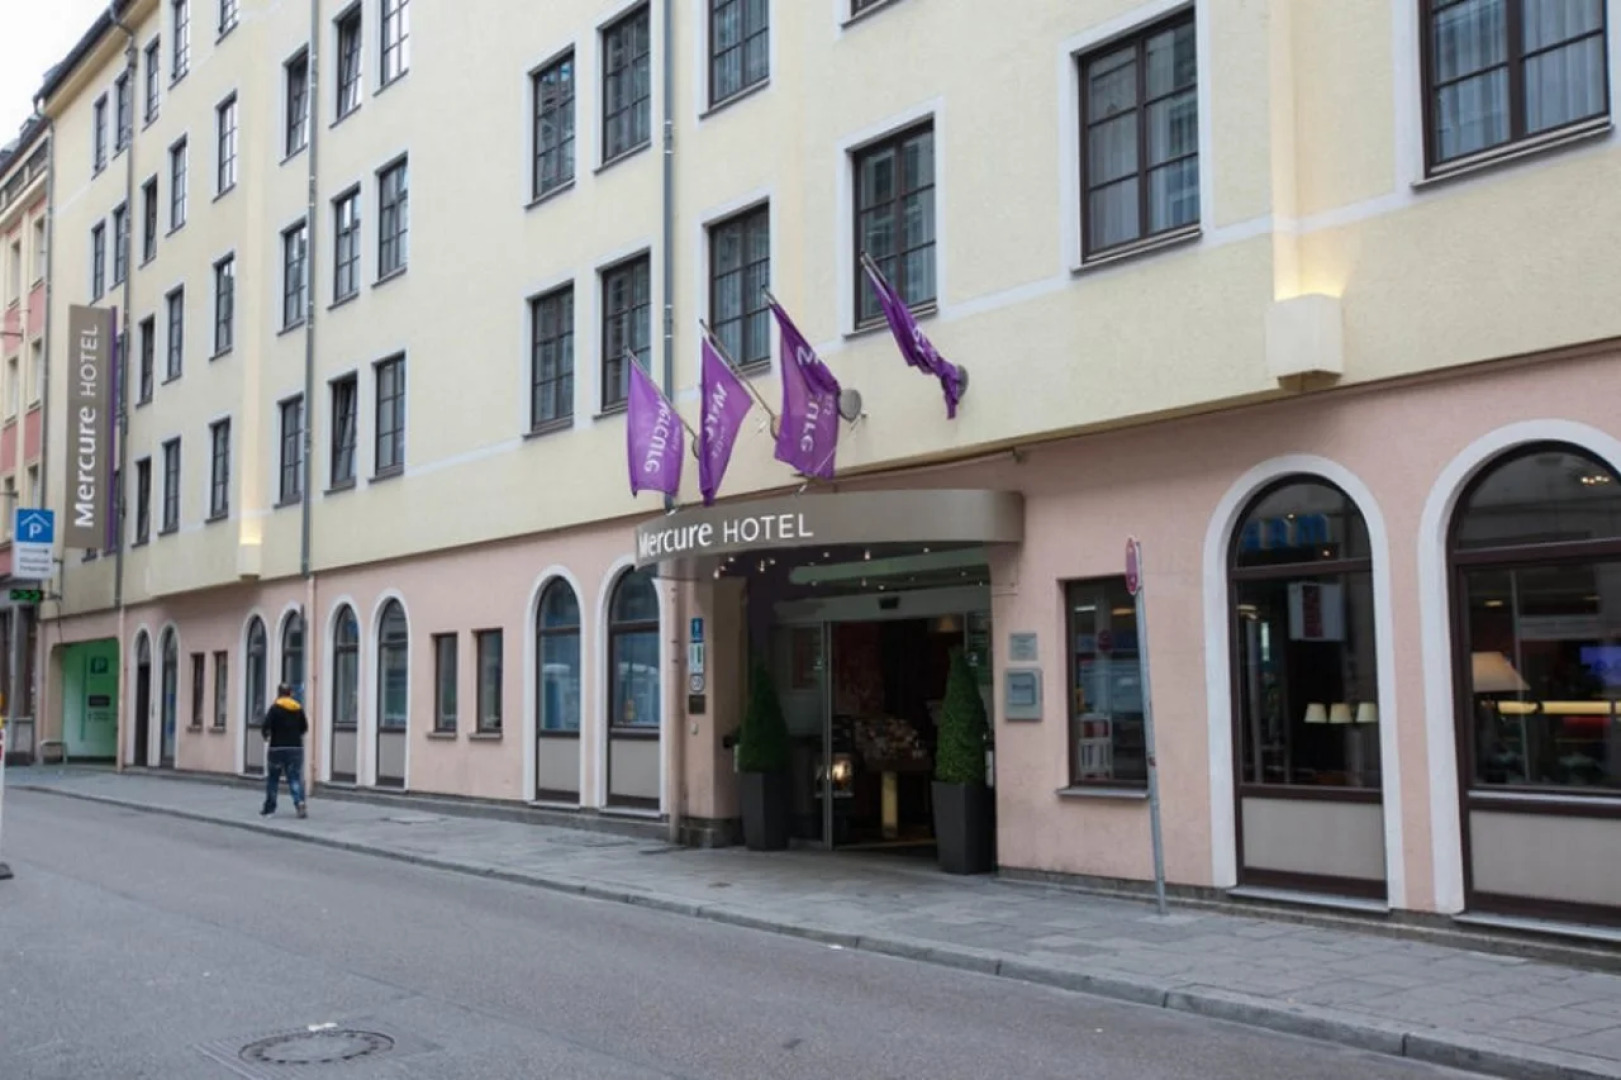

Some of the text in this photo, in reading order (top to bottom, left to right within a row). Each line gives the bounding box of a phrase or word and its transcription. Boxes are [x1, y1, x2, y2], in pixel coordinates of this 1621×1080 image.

[75, 325, 99, 528] Mercure HOTEL
[29, 523, 42, 539] P
[638, 513, 814, 558] Mercure HOTEL
